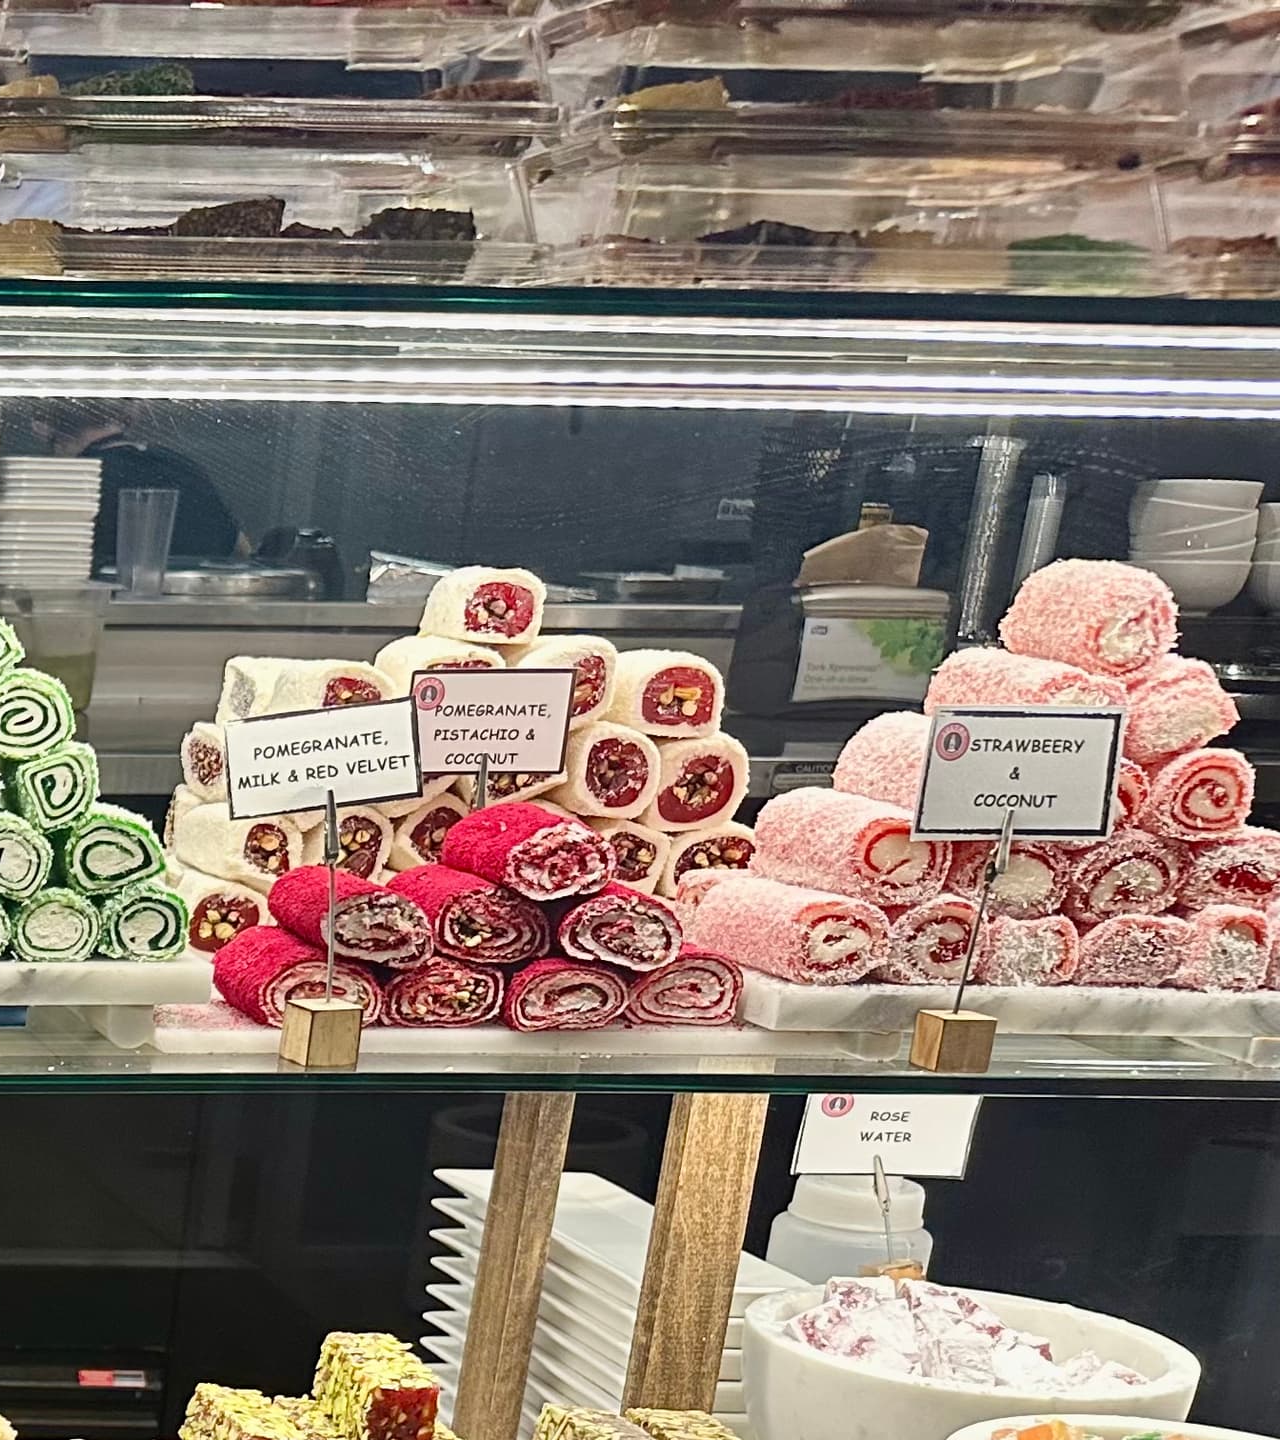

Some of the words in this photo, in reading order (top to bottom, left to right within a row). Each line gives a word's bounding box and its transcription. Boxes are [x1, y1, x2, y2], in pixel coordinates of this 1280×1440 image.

[434, 703, 552, 719] POMEGRANATE,
[433, 728, 520, 742] PISTACHIO
[525, 729, 535, 741] &
[253, 730, 389, 760] POMEGRANATE,
[970, 738, 1086, 754] STRAWBEERY
[238, 771, 280, 790] MILK
[287, 769, 299, 783] &
[305, 764, 339, 781] RED
[345, 755, 411, 776] VELVET
[1008, 766, 1020, 780] &
[973, 794, 1058, 809] COCONUT
[869, 1111, 912, 1123] ROSE
[859, 1131, 913, 1143] WATER
